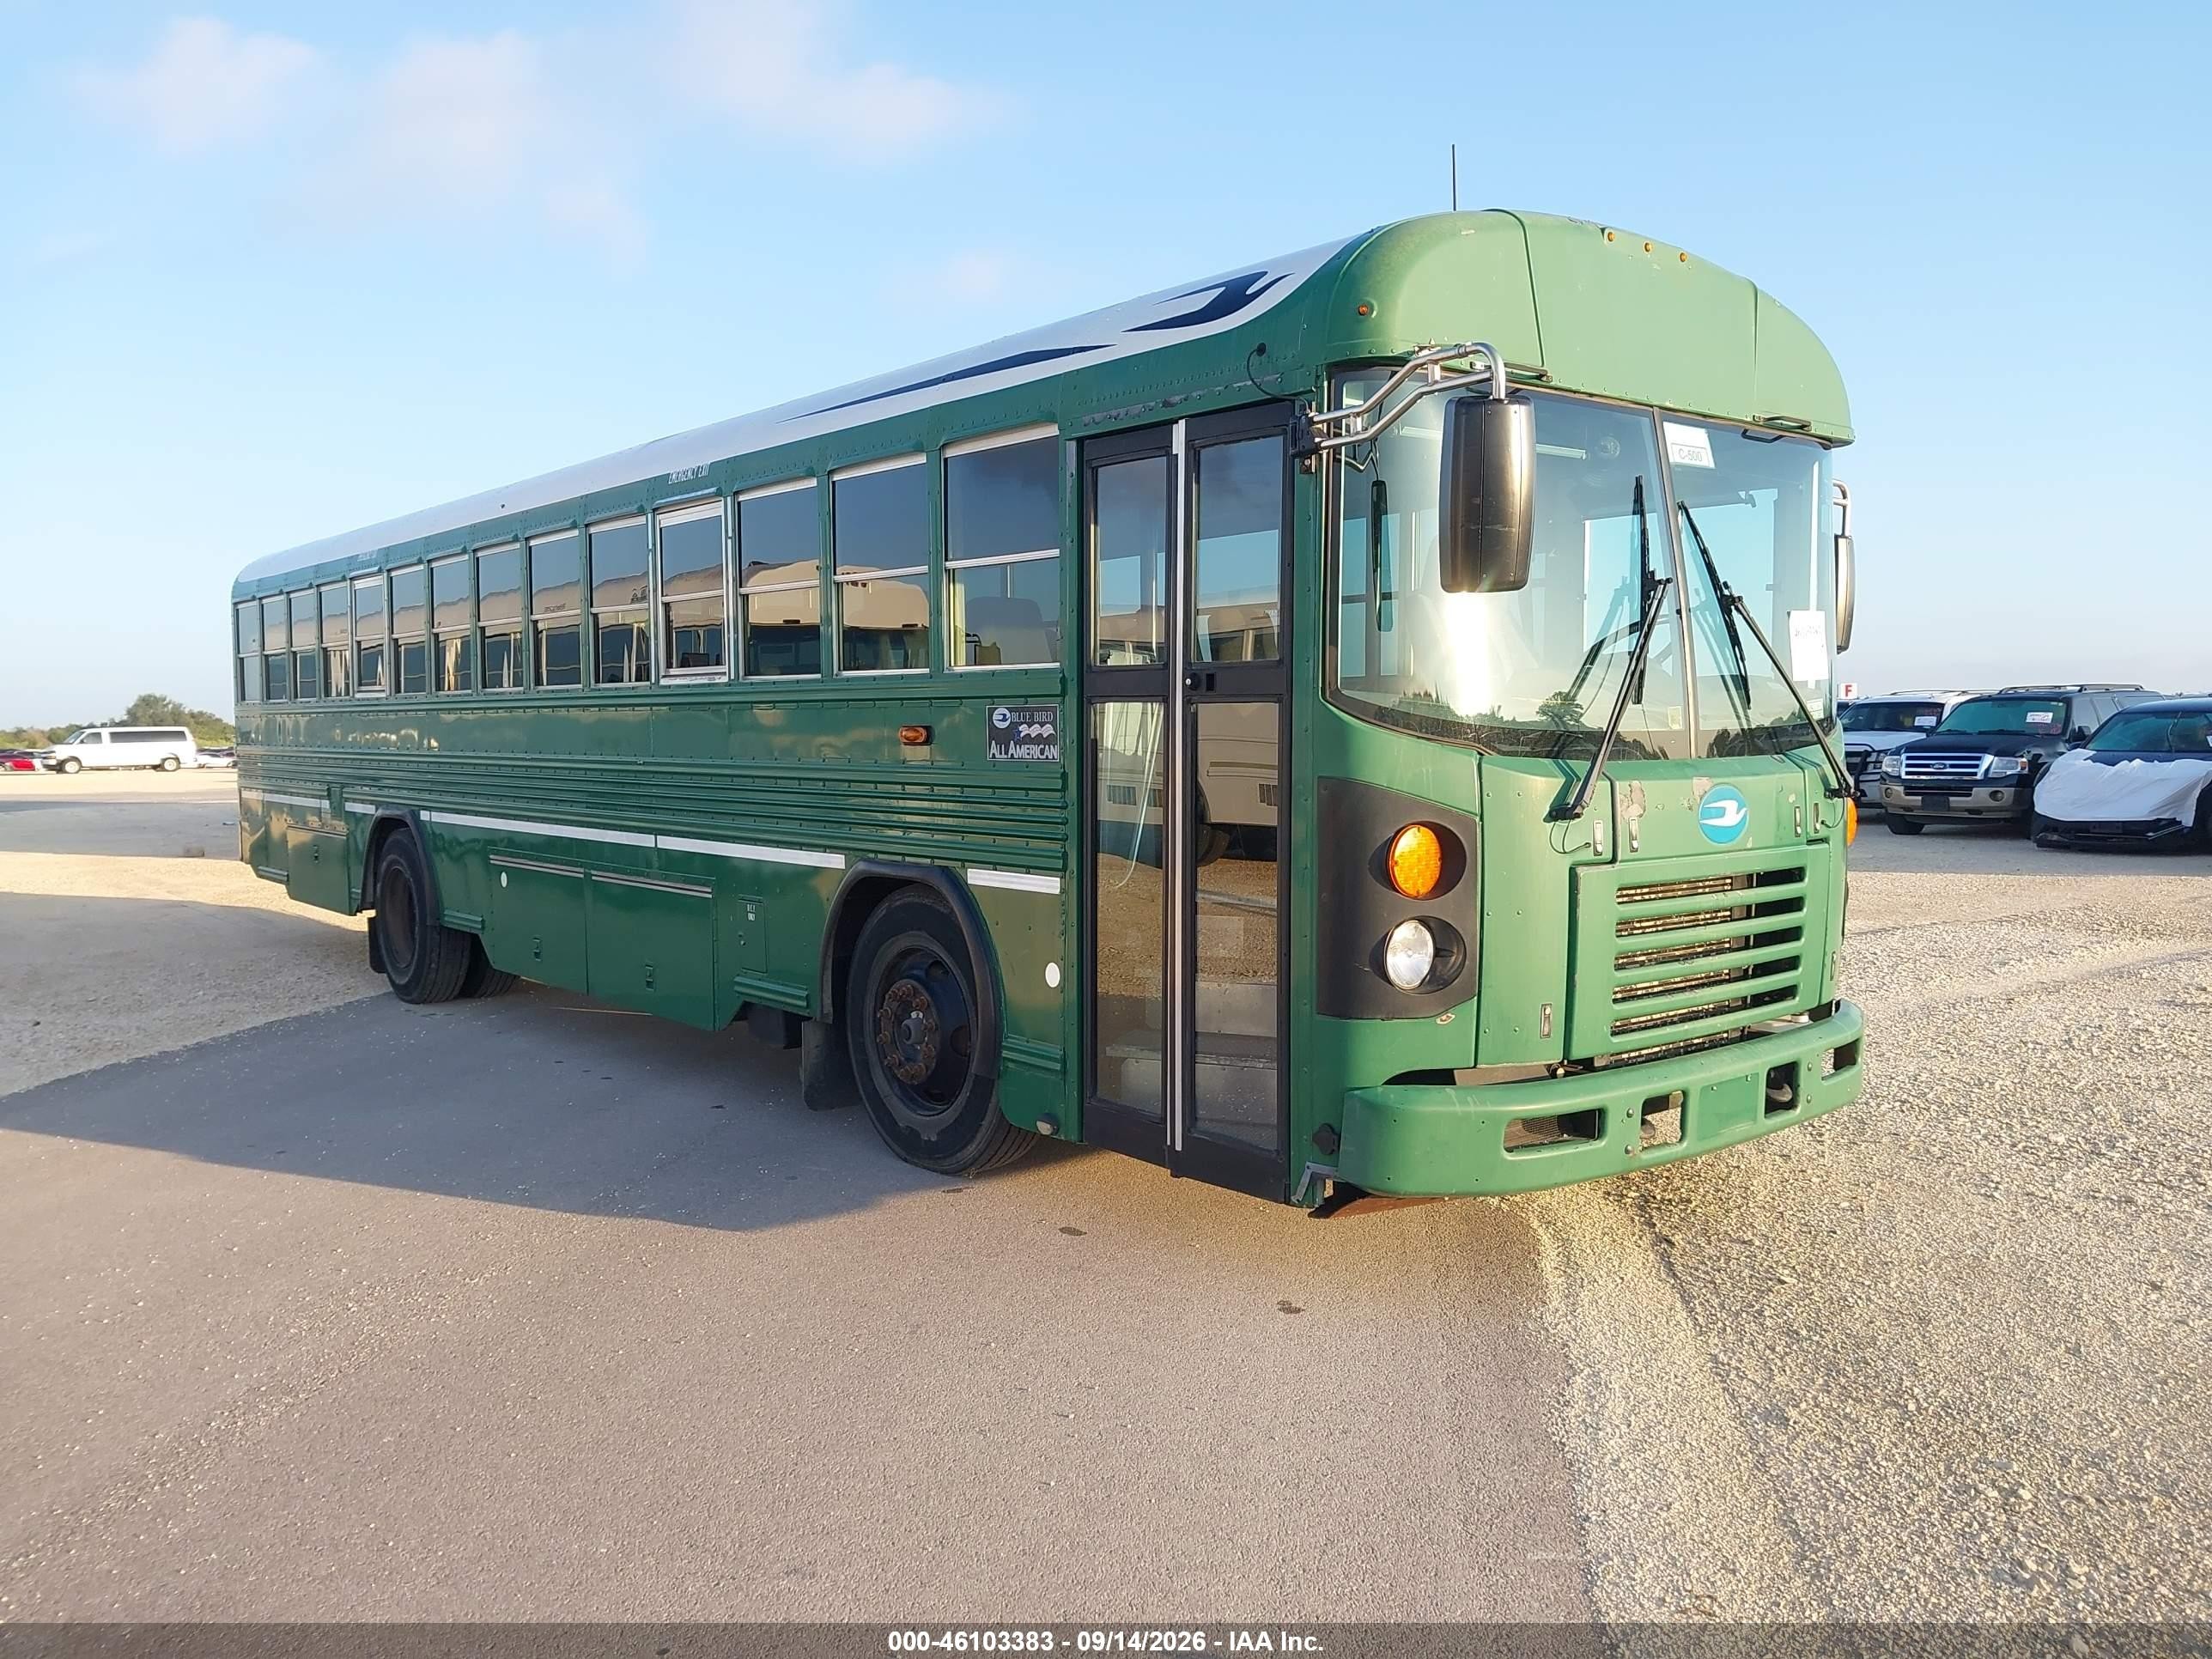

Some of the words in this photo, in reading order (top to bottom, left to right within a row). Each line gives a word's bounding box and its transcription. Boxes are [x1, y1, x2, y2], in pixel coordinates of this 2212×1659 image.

[1678, 448, 1703, 462] C-500
[668, 466, 698, 484] EMERGENCY
[698, 463, 711, 477] EXIT
[1845, 684, 1852, 696] F
[1012, 712, 1031, 722] BLUE
[1034, 711, 1054, 722] BIRD
